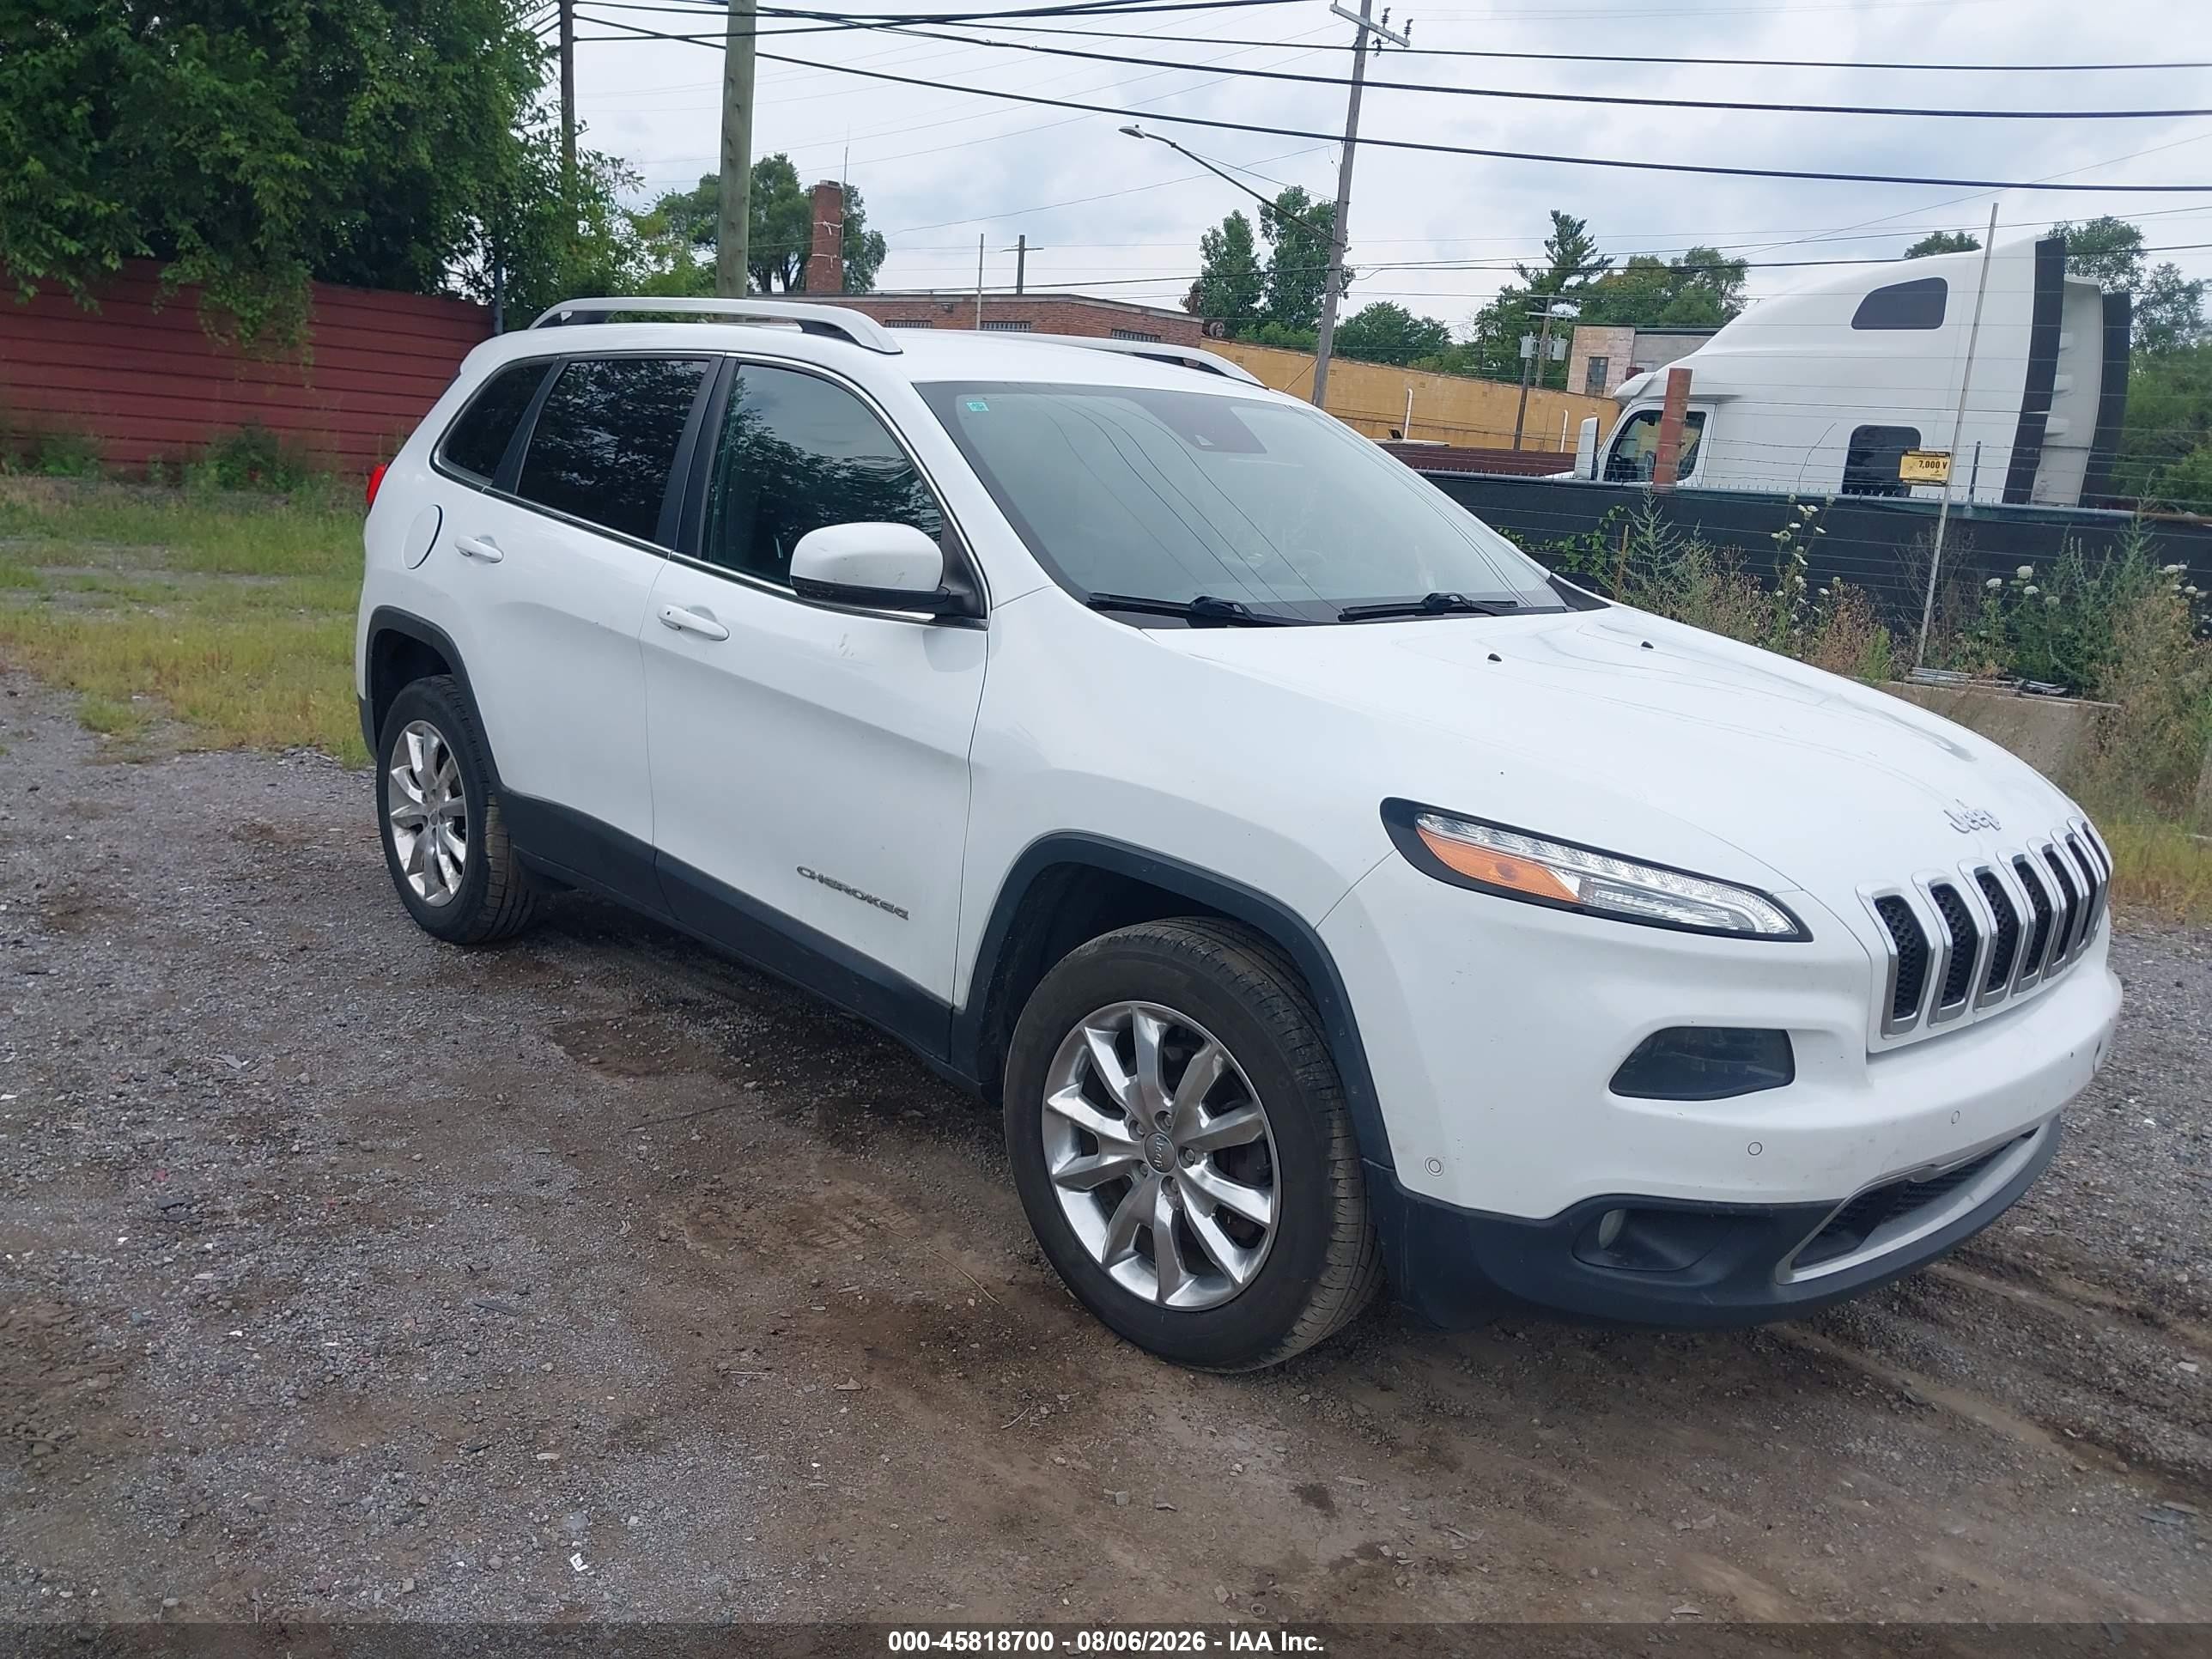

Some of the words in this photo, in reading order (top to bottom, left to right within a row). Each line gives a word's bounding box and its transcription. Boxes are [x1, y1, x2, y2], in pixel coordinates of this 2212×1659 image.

[1918, 460, 1941, 469] 7,000
[1942, 461, 1948, 470] V
[1942, 798, 2002, 834] Jeep
[796, 866, 909, 921] CHEROKEE
[1153, 1135, 1165, 1168] Jeep
